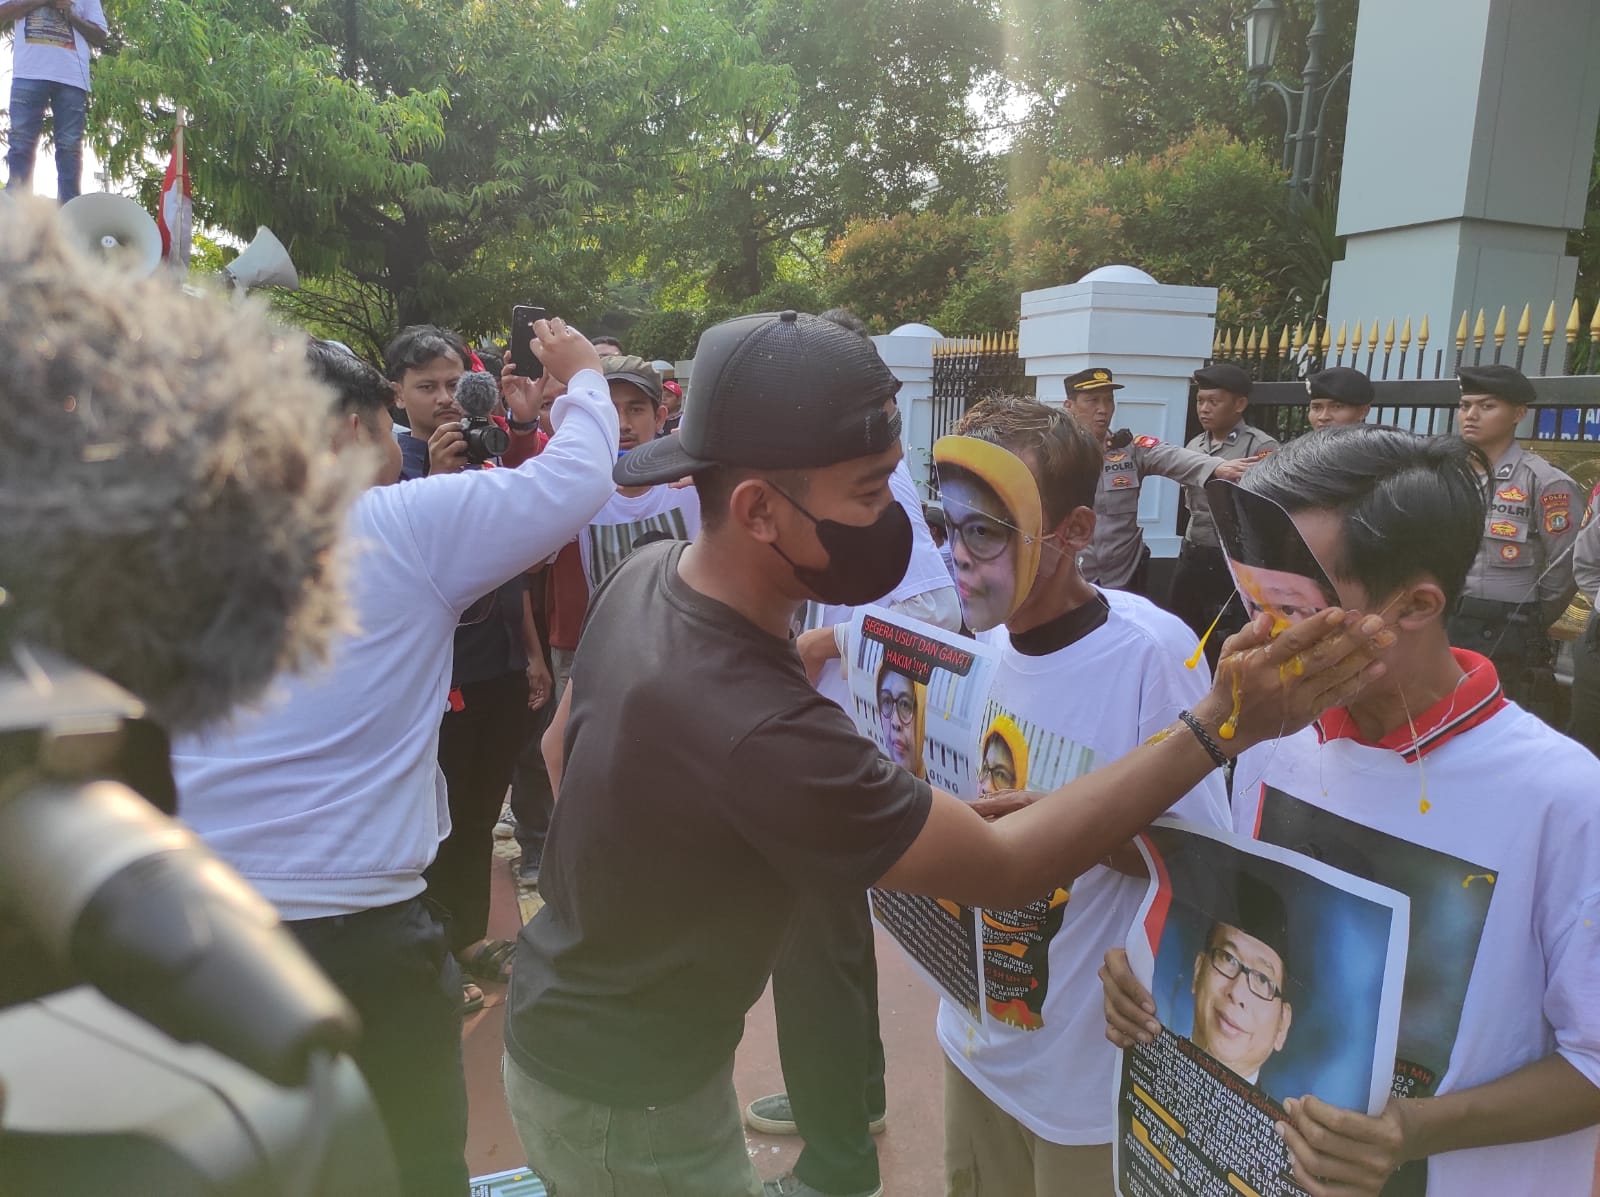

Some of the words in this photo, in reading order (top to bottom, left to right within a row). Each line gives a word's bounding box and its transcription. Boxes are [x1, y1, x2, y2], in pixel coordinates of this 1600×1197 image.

[1105, 462, 1133, 473] POLRI
[1490, 504, 1530, 517] POLRI
[1543, 494, 1567, 503] POLDA
[865, 618, 894, 640] SEGERA
[895, 630, 919, 648] USUT
[918, 639, 940, 657] DAN
[940, 646, 971, 669] GANTI
[887, 649, 912, 671] HAKIM
[929, 769, 959, 794] GUNG
[1161, 1032, 1177, 1045] AKIM
[1156, 1068, 1174, 1086] BUKTI
[1177, 1086, 1205, 1114] PUTUSAN
[1208, 1112, 1215, 1124] YG
[1217, 1121, 1280, 1175] BERTENTANGAN
[1199, 1068, 1244, 1106] PENINJAUAN
[1246, 1104, 1274, 1127] KEMBA
[1205, 1082, 1212, 1094] KE
[1213, 1090, 1256, 1125] MOHINDAR
[1258, 1123, 1270, 1135] HB
[1273, 1133, 1283, 1145] YG
[1211, 1097, 1249, 1131] MELAWAN
[1134, 1107, 1138, 1116] &
[1139, 1113, 1151, 1129] ADA
[1152, 1125, 1156, 1134] 2
[1175, 1147, 1202, 1179] PUTUSAN
[1204, 1177, 1224, 1197] YANG
[1176, 1103, 1204, 1133] PUTUSAN
[1206, 1130, 1248, 1170] MAHKAMAH
[1250, 1167, 1281, 1195] AGUNG
[1187, 1131, 1200, 1148] ADA
[1201, 1144, 1213, 1161] APA
[1215, 1158, 1226, 1173] ???
[1197, 1094, 1202, 1102] &
[1203, 1100, 1217, 1115] DPO
[1218, 1112, 1235, 1129] DAN
[1235, 1126, 1256, 1146] JUGA
[1258, 1143, 1287, 1170] SUDAH
[1212, 1127, 1260, 1169] TERTANGGAL
[1263, 1168, 1272, 1178] 18
[1177, 1140, 1186, 1154] HB
[1187, 1150, 1210, 1177] DIDUGA
[1212, 1175, 1233, 1197] KUAT
[1187, 1169, 1200, 1187] BISA
[1203, 1137, 1248, 1180] TERTANGGAL
[1251, 1178, 1260, 1189] 14
